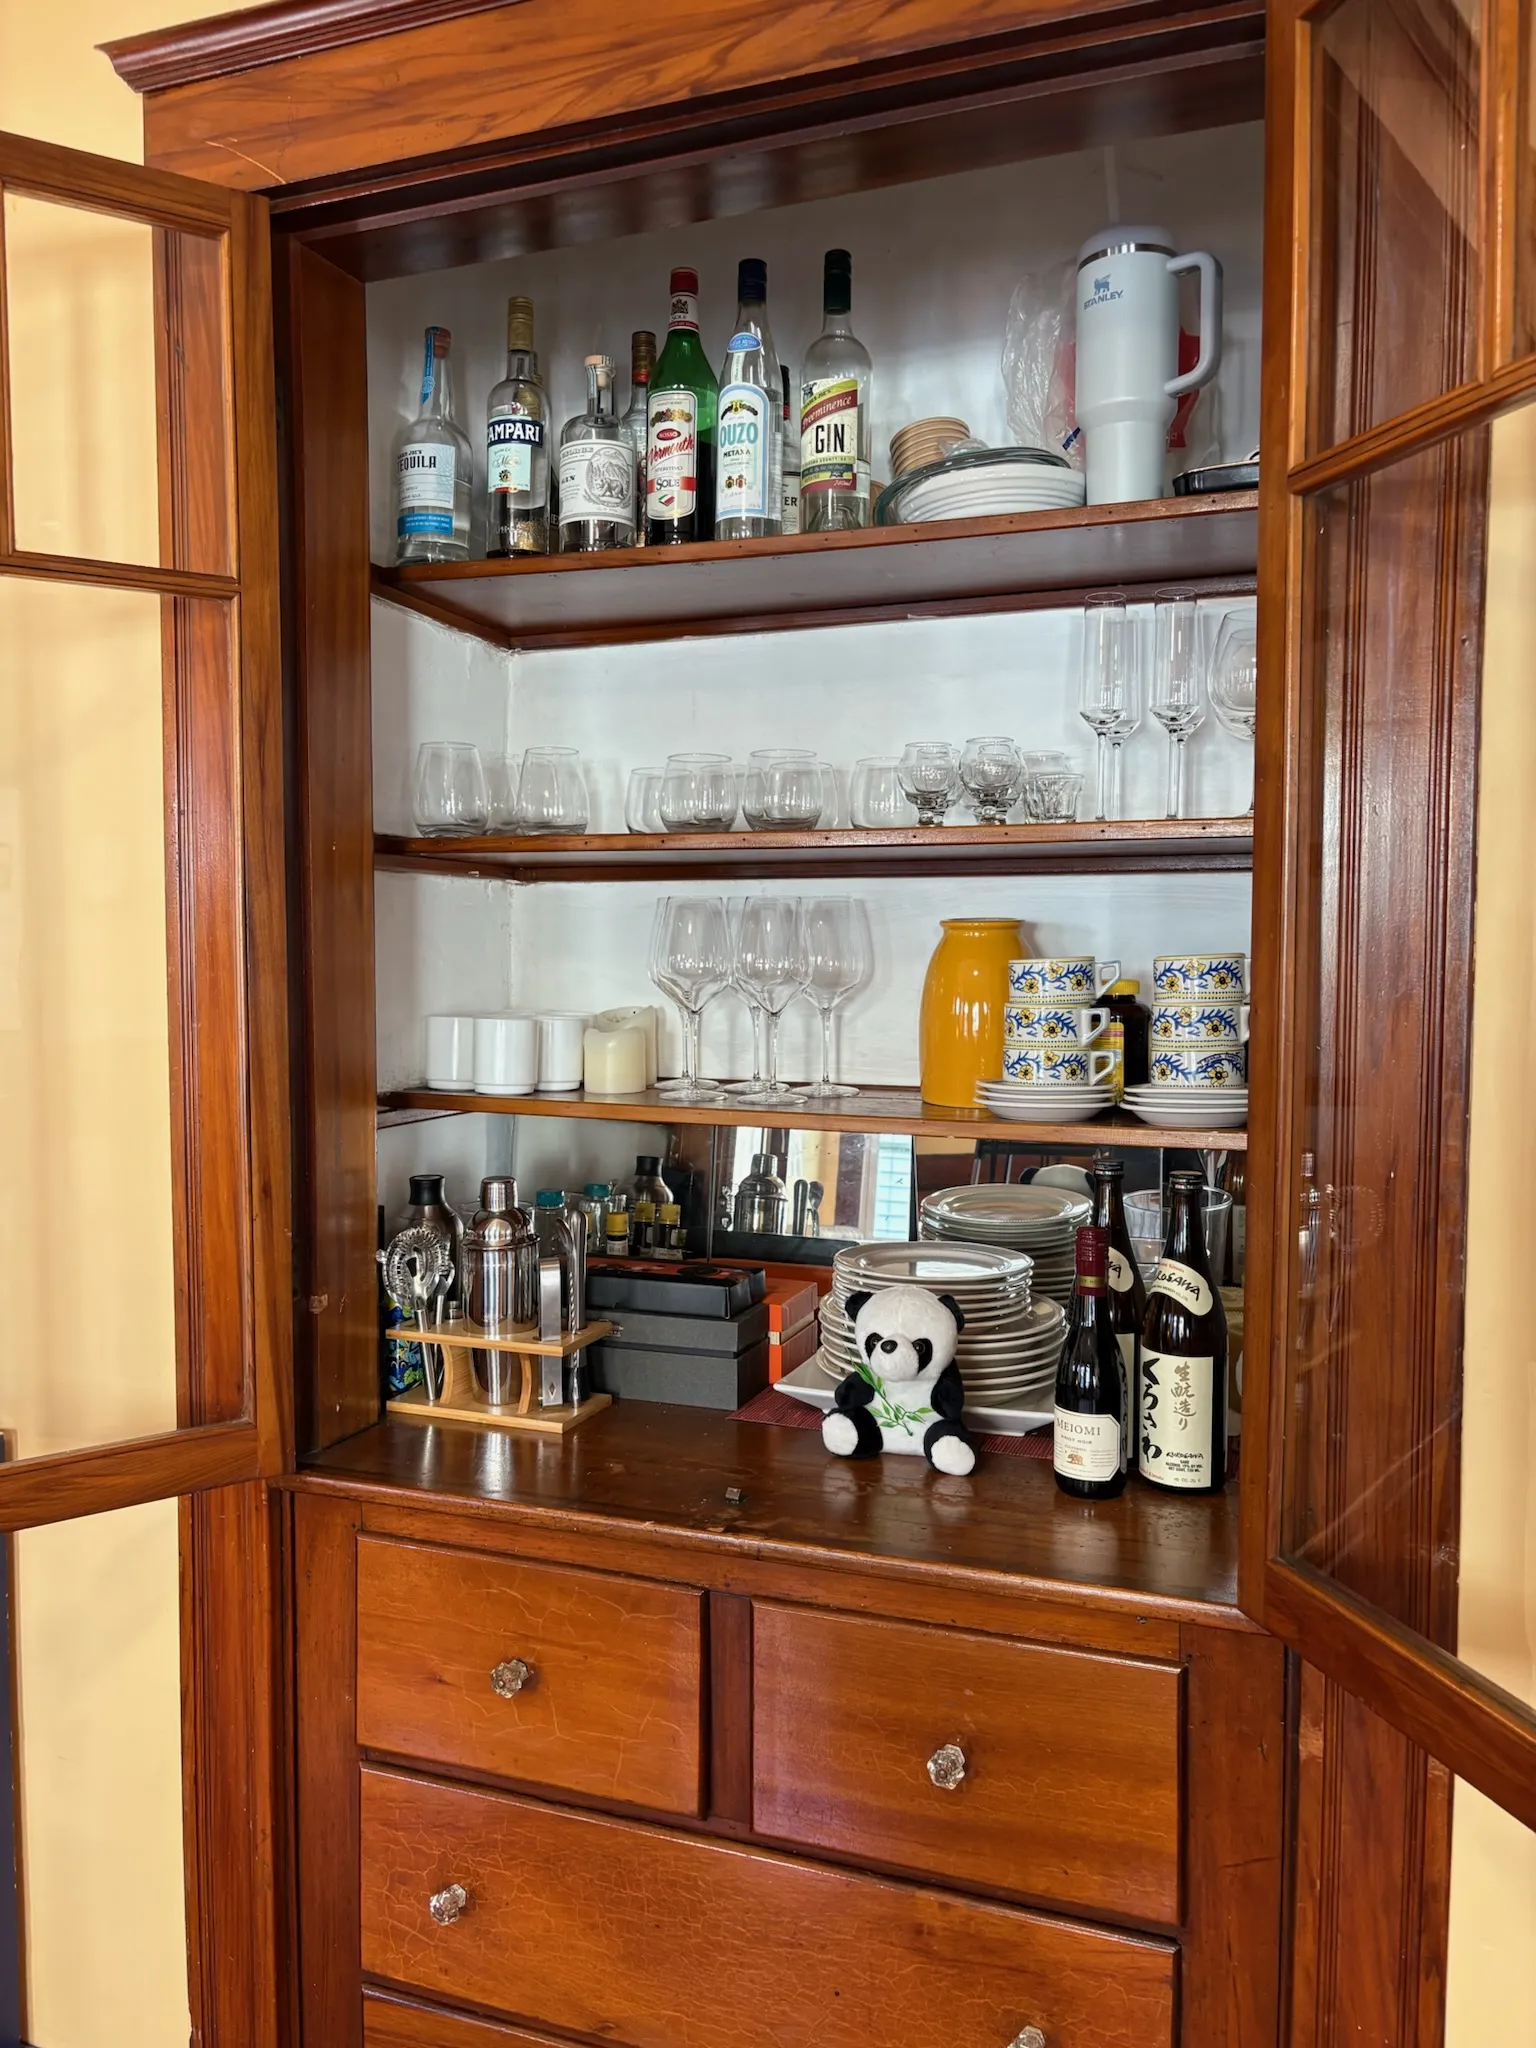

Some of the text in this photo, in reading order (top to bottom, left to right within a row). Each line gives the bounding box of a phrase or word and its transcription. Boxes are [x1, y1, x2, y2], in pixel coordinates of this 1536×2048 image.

[1084, 289, 1123, 310] STANLEY
[802, 396, 852, 430] Preeminence
[488, 423, 540, 442] AMPARI
[720, 422, 758, 448] OUZO
[815, 424, 845, 454] GIN
[649, 433, 694, 465] Vermouth
[723, 448, 751, 458] METAXA
[397, 455, 437, 474] TEQUILA
[782, 496, 798, 507] ER
[1142, 1358, 1162, 1463] くろさわ
[1056, 1417, 1101, 1436] MEIOMI
